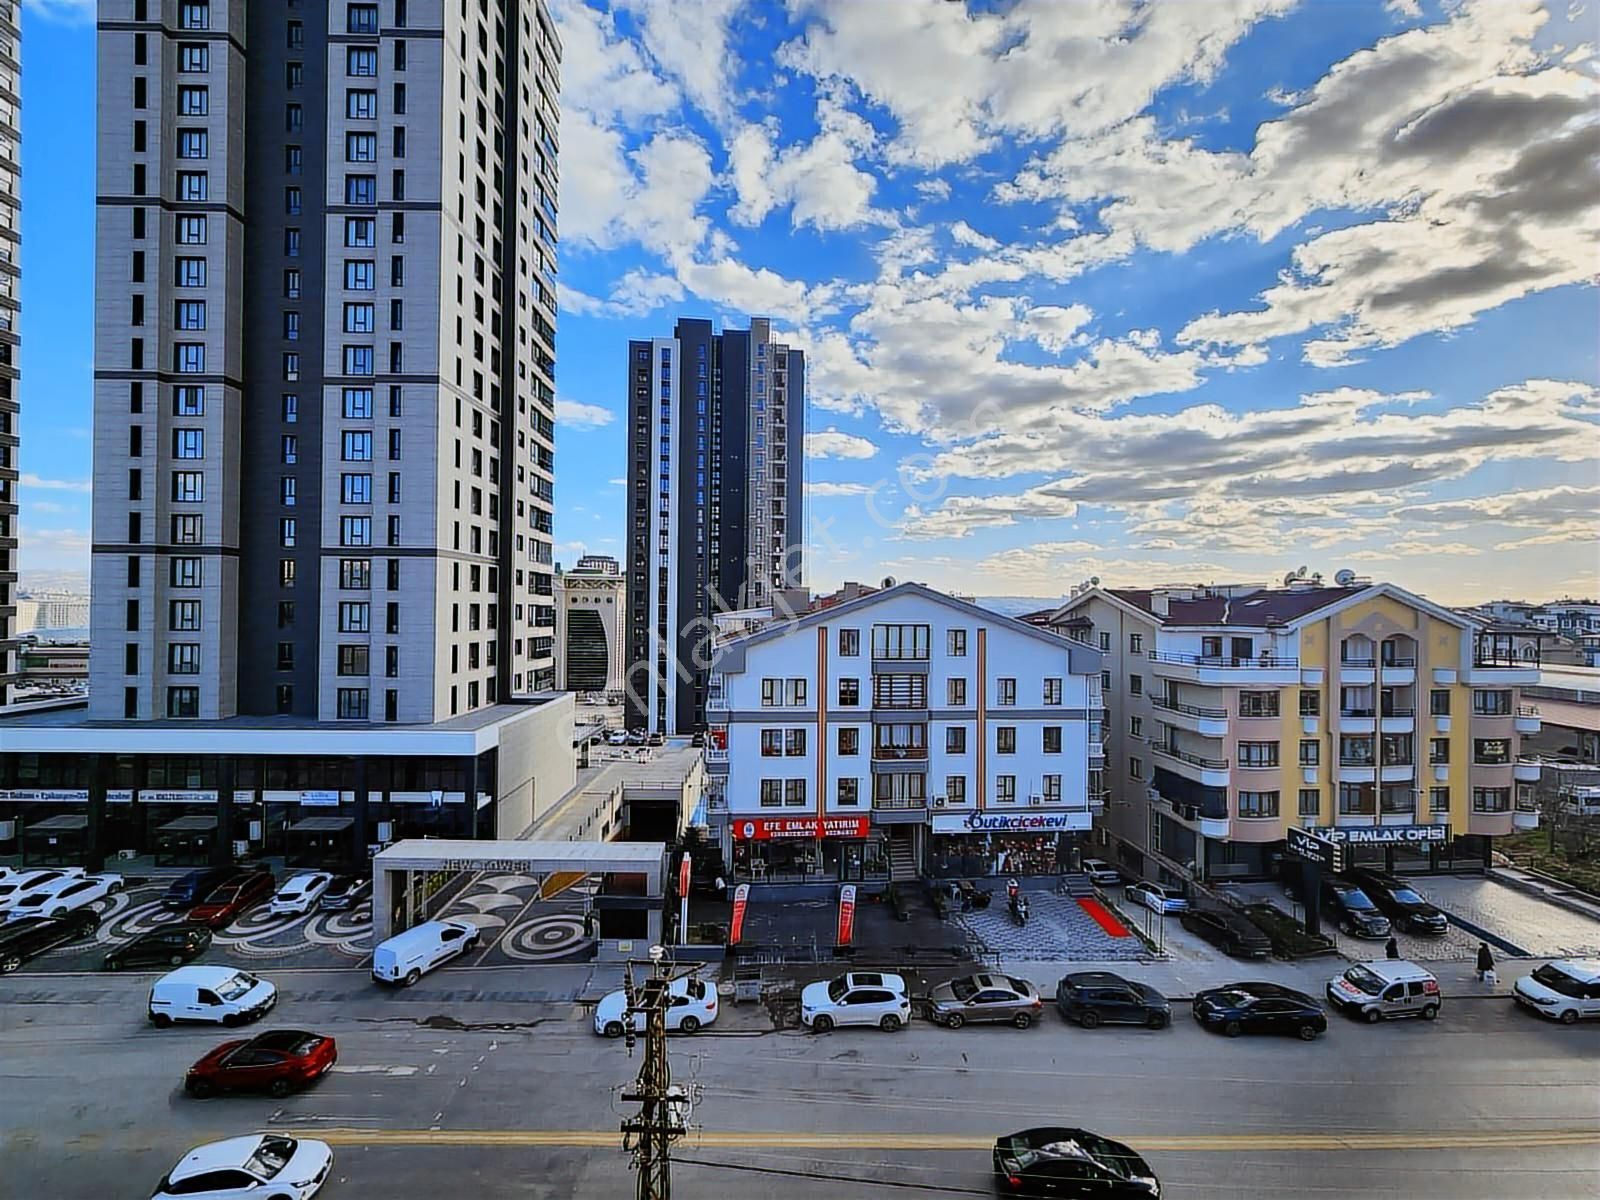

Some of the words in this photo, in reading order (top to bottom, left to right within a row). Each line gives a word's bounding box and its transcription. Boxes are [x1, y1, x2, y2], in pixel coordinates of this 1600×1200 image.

[763, 821, 781, 831] EFE
[786, 820, 818, 830] EMLAK
[822, 819, 860, 829] YATIRIM
[1349, 829, 1404, 842] EMLAK
[480, 859, 531, 871] TOWER
